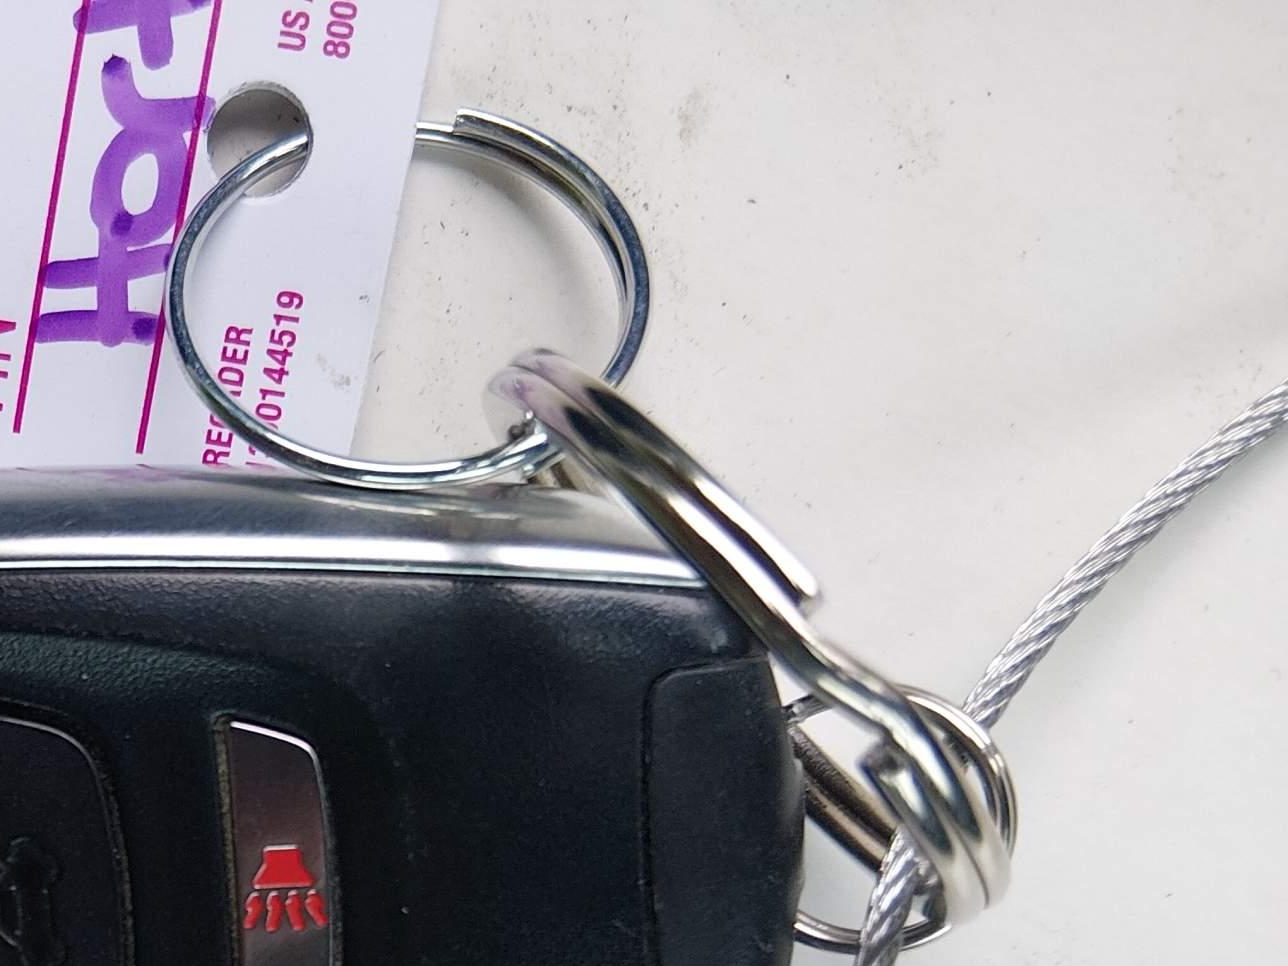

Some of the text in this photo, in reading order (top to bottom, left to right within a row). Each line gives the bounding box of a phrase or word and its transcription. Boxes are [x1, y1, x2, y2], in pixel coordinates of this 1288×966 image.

[277, 9, 311, 52] US
[322, 0, 358, 60] 800
[201, 324, 254, 466] REDER
